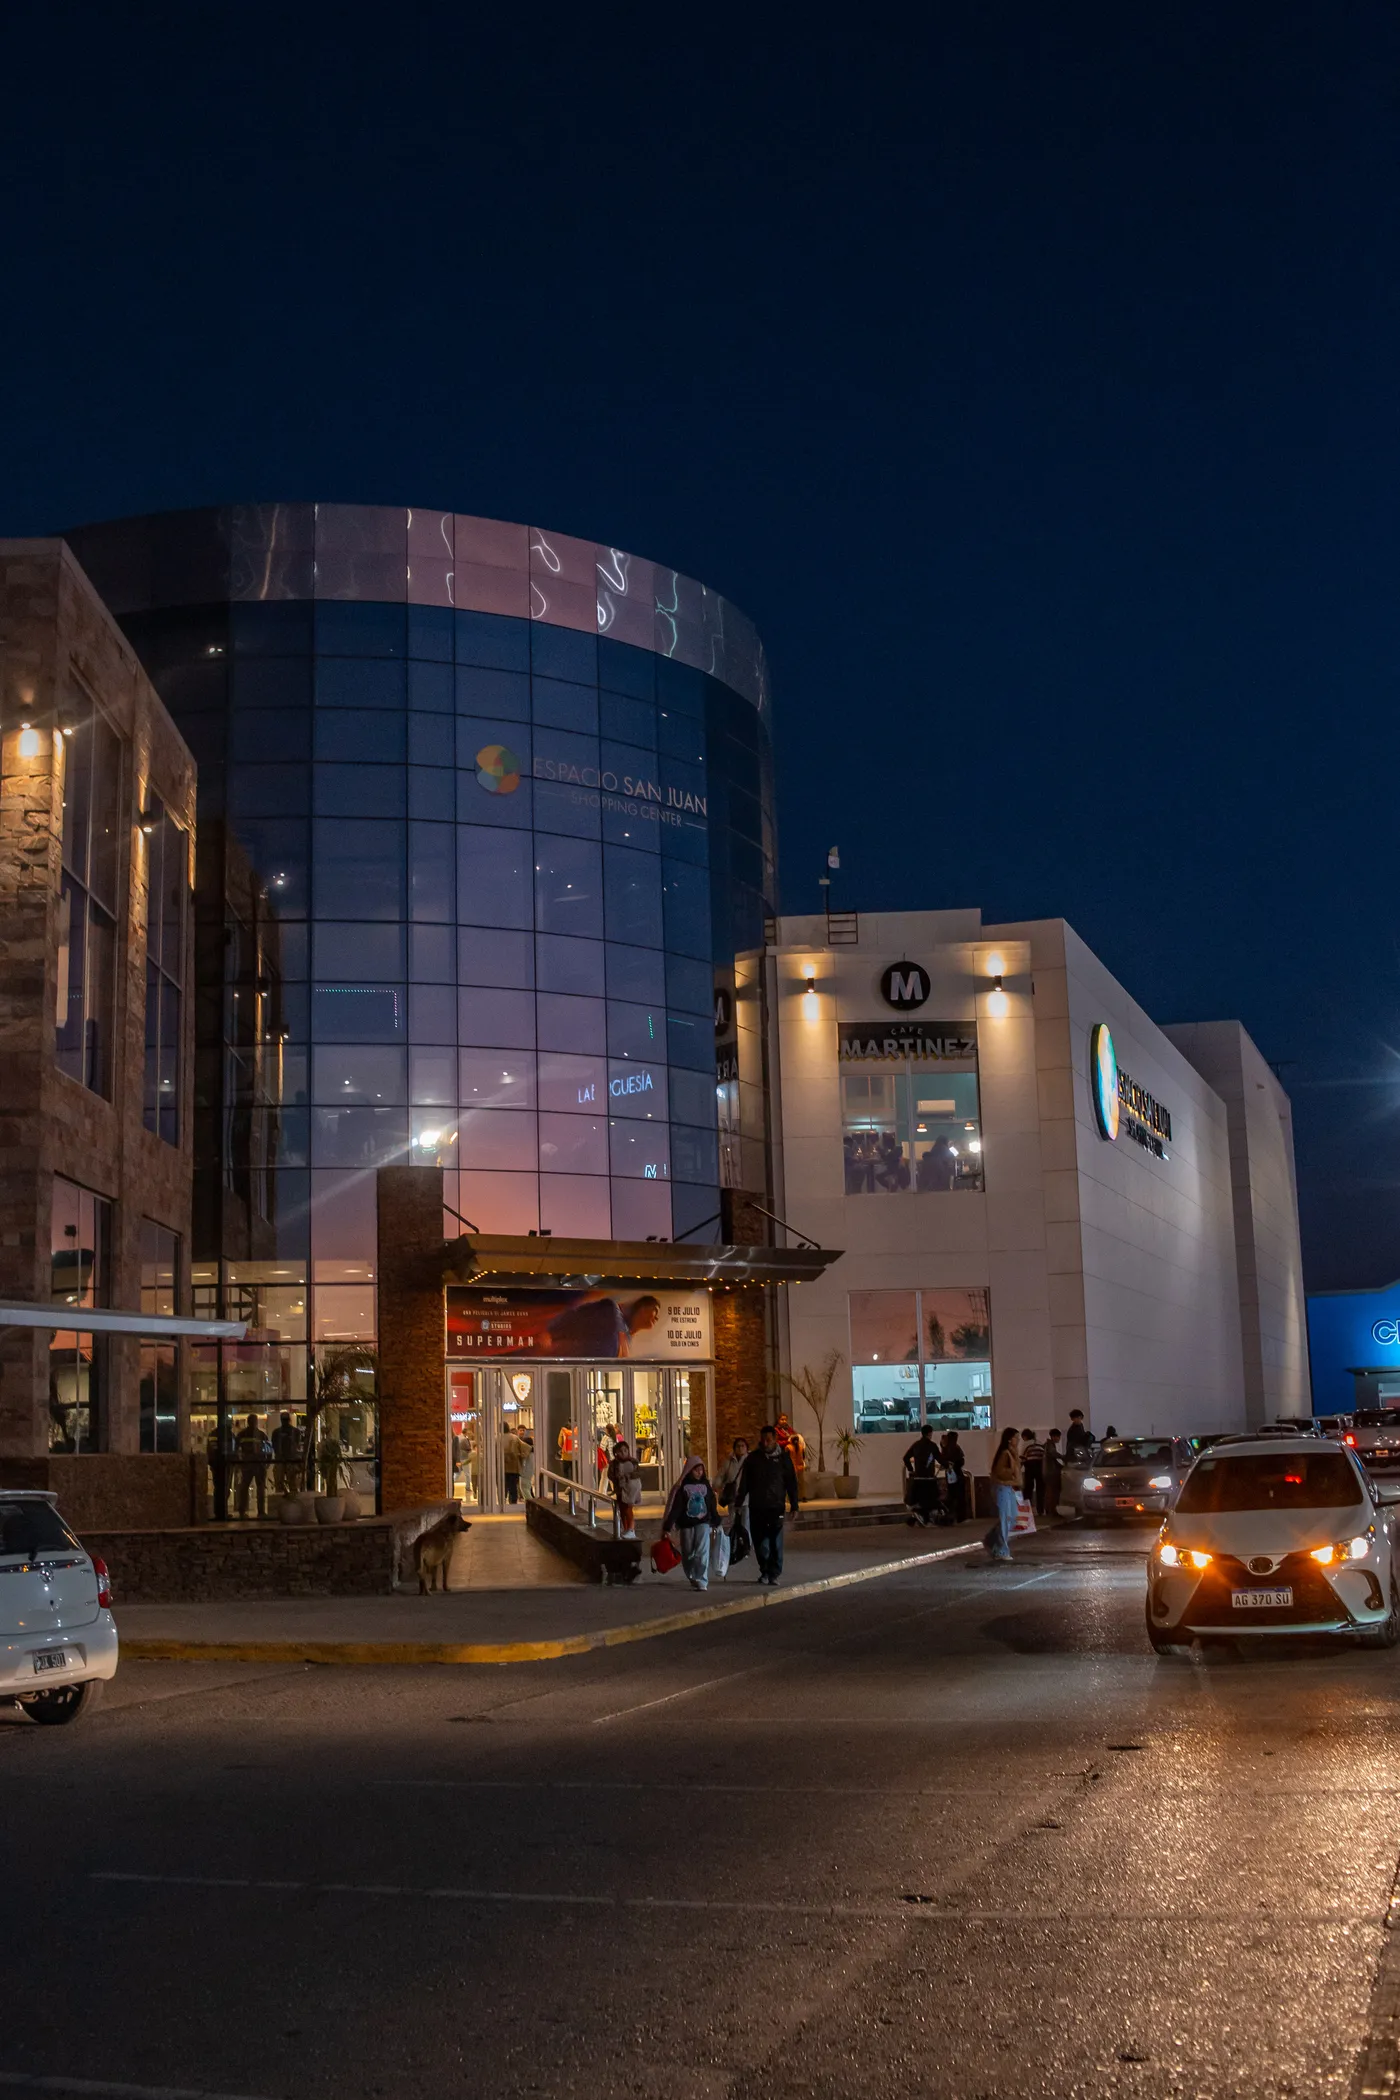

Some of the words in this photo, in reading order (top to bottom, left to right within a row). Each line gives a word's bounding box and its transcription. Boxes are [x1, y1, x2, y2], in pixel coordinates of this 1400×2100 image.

[532, 757, 618, 792] ESPACIO
[623, 776, 662, 802] SAN
[666, 786, 708, 816] JUAN
[571, 792, 638, 816] SHOPPING
[640, 806, 682, 827] CENTER
[890, 971, 924, 1001] M
[840, 1038, 977, 1059] MARTINEZ
[667, 1306, 673, 1316] 9
[673, 1306, 681, 1316] DE
[682, 1306, 701, 1316] JULIO
[456, 1335, 534, 1347] SUPERMAN
[667, 1330, 674, 1339] 10
[675, 1330, 683, 1339] DE
[684, 1330, 702, 1340] JULIO
[1235, 1594, 1248, 1606] AG
[1252, 1594, 1272, 1605] 370
[1276, 1593, 1289, 1605] SU
